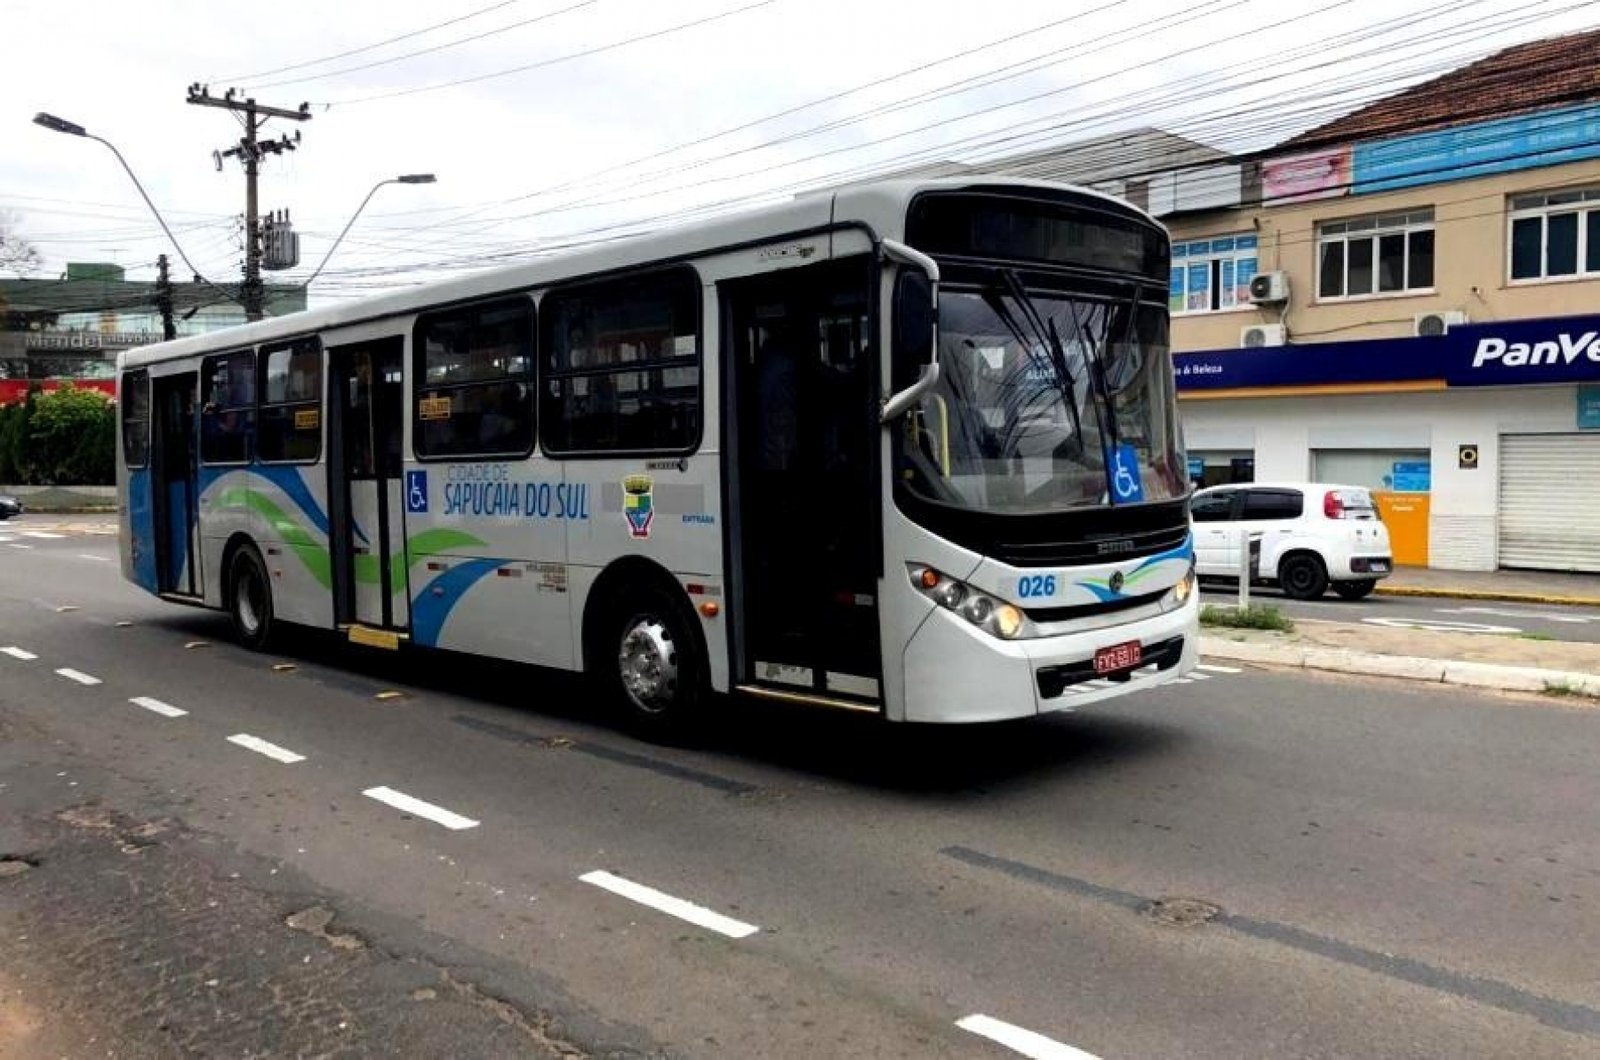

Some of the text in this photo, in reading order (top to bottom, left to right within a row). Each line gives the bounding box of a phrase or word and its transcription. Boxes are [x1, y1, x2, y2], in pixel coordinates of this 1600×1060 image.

[447, 463, 508, 481] CIDADE DE
[444, 483, 588, 519] SAPUCAIA DO SUL
[1018, 575, 1055, 598] 026
